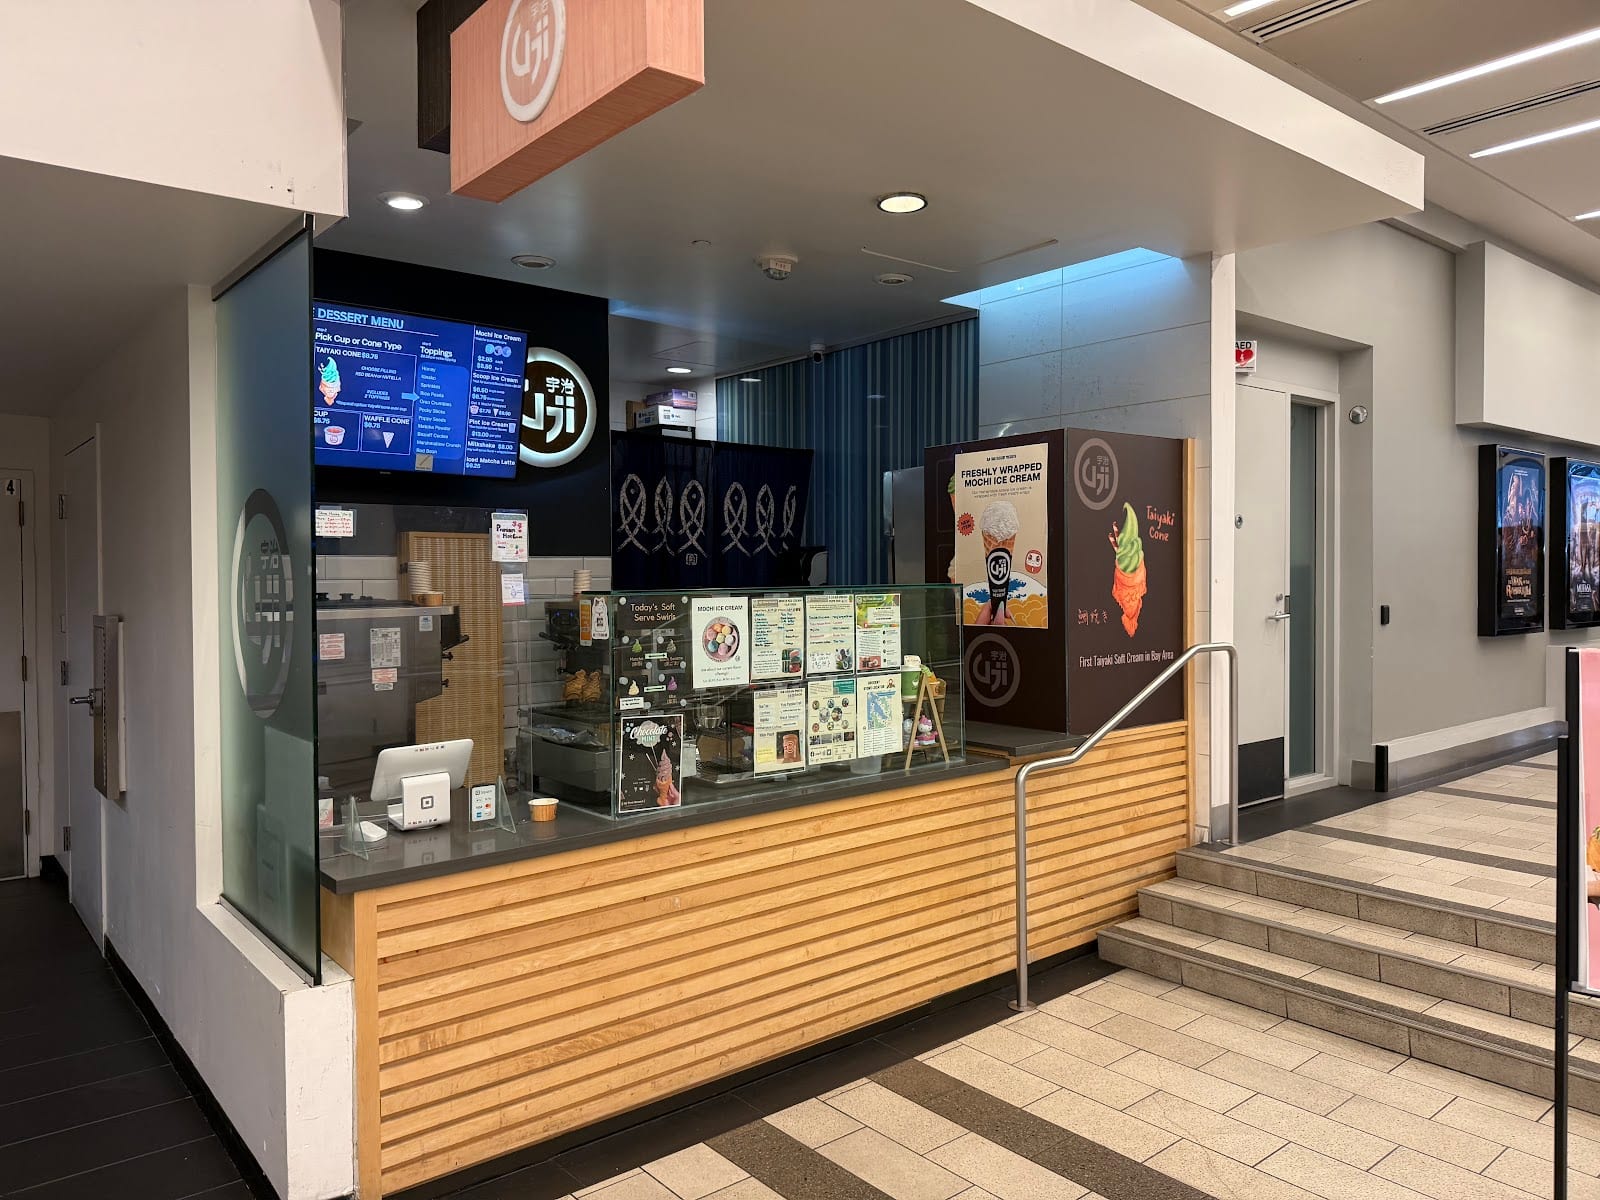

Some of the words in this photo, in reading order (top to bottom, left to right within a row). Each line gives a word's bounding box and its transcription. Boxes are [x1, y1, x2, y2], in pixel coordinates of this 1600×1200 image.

[318, 307, 369, 324] DESSERT
[370, 315, 404, 329] MENU
[315, 332, 333, 342] Pick
[334, 335, 351, 345] Cup
[361, 339, 382, 348] Cone
[383, 341, 402, 351] Type
[476, 330, 494, 338] Mochi
[503, 334, 521, 342] Cream
[316, 346, 341, 356] TAIYAKI
[342, 350, 362, 358] CONE
[420, 346, 453, 358] Toppings
[1235, 341, 1252, 350] AED
[472, 372, 491, 380] Scoop
[500, 376, 518, 384] Cream
[545, 376, 576, 395] 宇治
[364, 415, 391, 424] WAFFLE
[391, 417, 410, 425] CONE
[467, 441, 496, 449] Milkshake
[479, 457, 501, 465] Matcha
[961, 467, 1000, 479] FRESHLY
[999, 462, 1043, 475] WRAPPED
[1082, 457, 1110, 496] Uji
[6, 479, 15, 495] 4
[964, 475, 992, 488] MOCHI
[994, 475, 1008, 485] ICE
[1010, 472, 1041, 483] CREAM
[1146, 505, 1176, 530] Taiyaki
[1149, 525, 1169, 542] Cone
[630, 603, 659, 612] Today's
[661, 602, 676, 611] Soft
[634, 613, 655, 622] Serve
[656, 613, 677, 622] Swirls
[1079, 655, 1093, 668] First
[1093, 653, 1113, 667] Taiyaki
[1114, 651, 1126, 665] Soft
[1126, 650, 1144, 664] Cream
[1145, 650, 1151, 662] in
[1151, 650, 1161, 663] Bay
[1161, 649, 1174, 661] Area
[973, 652, 1008, 692] Uji
[630, 725, 668, 740] Chocolate
